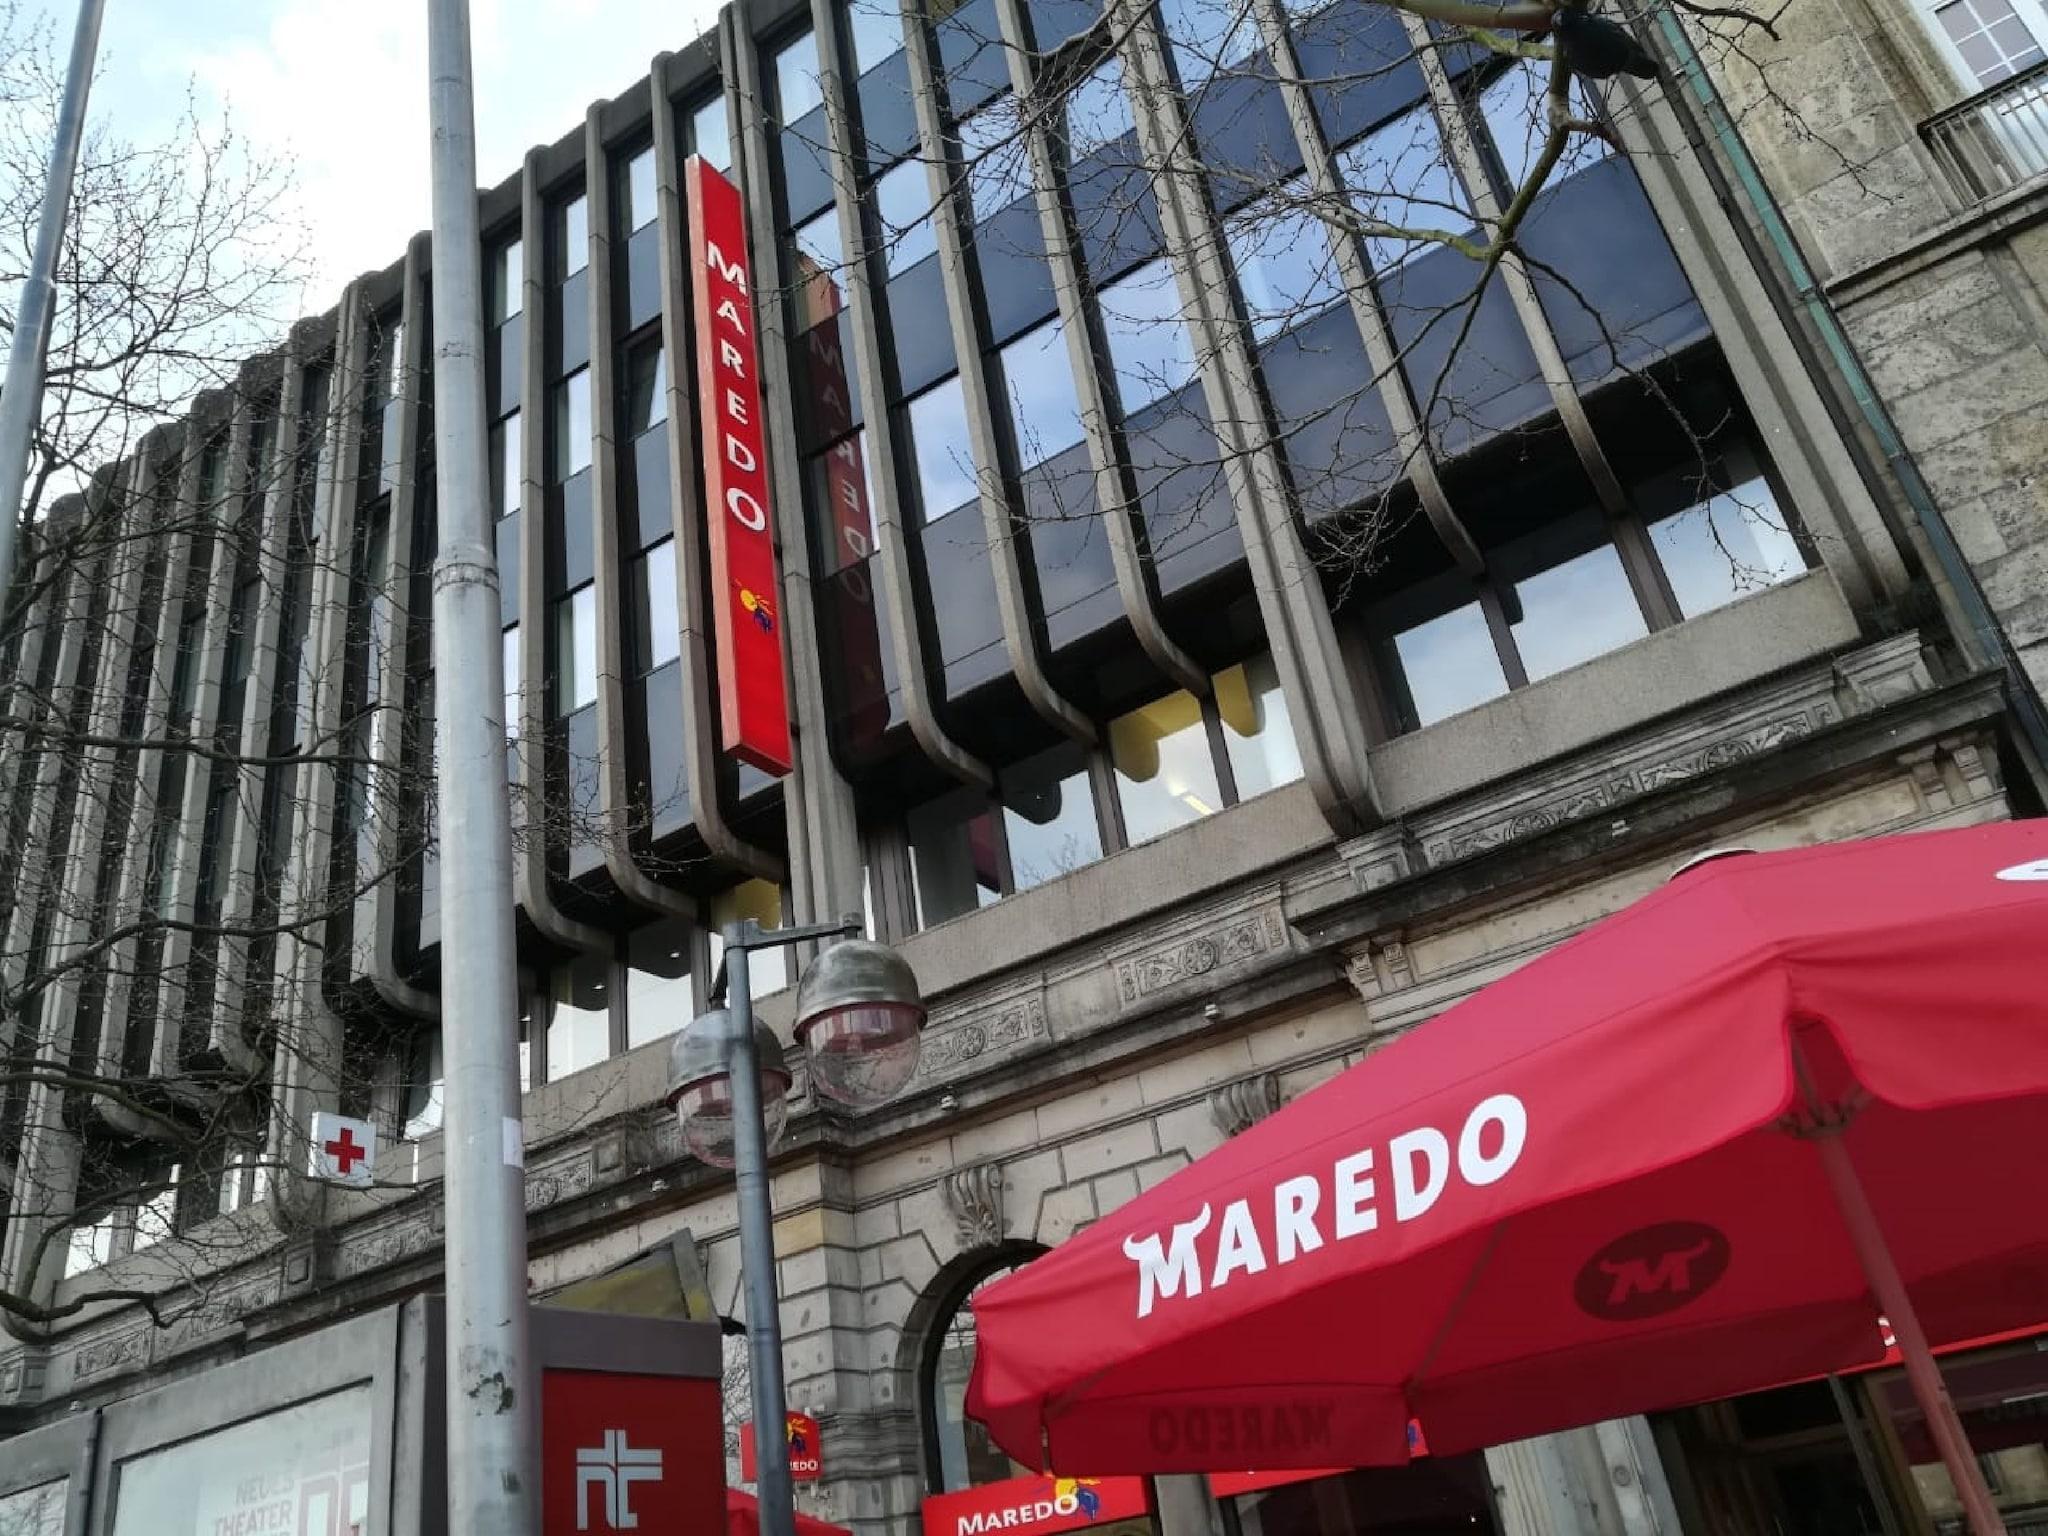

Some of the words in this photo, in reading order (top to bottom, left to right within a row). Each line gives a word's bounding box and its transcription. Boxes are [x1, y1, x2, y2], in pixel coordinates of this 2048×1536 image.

[707, 239, 766, 532] MAREDO
[1122, 1094, 1527, 1319] MAREDO
[957, 1493, 1080, 1536] MAREDO
